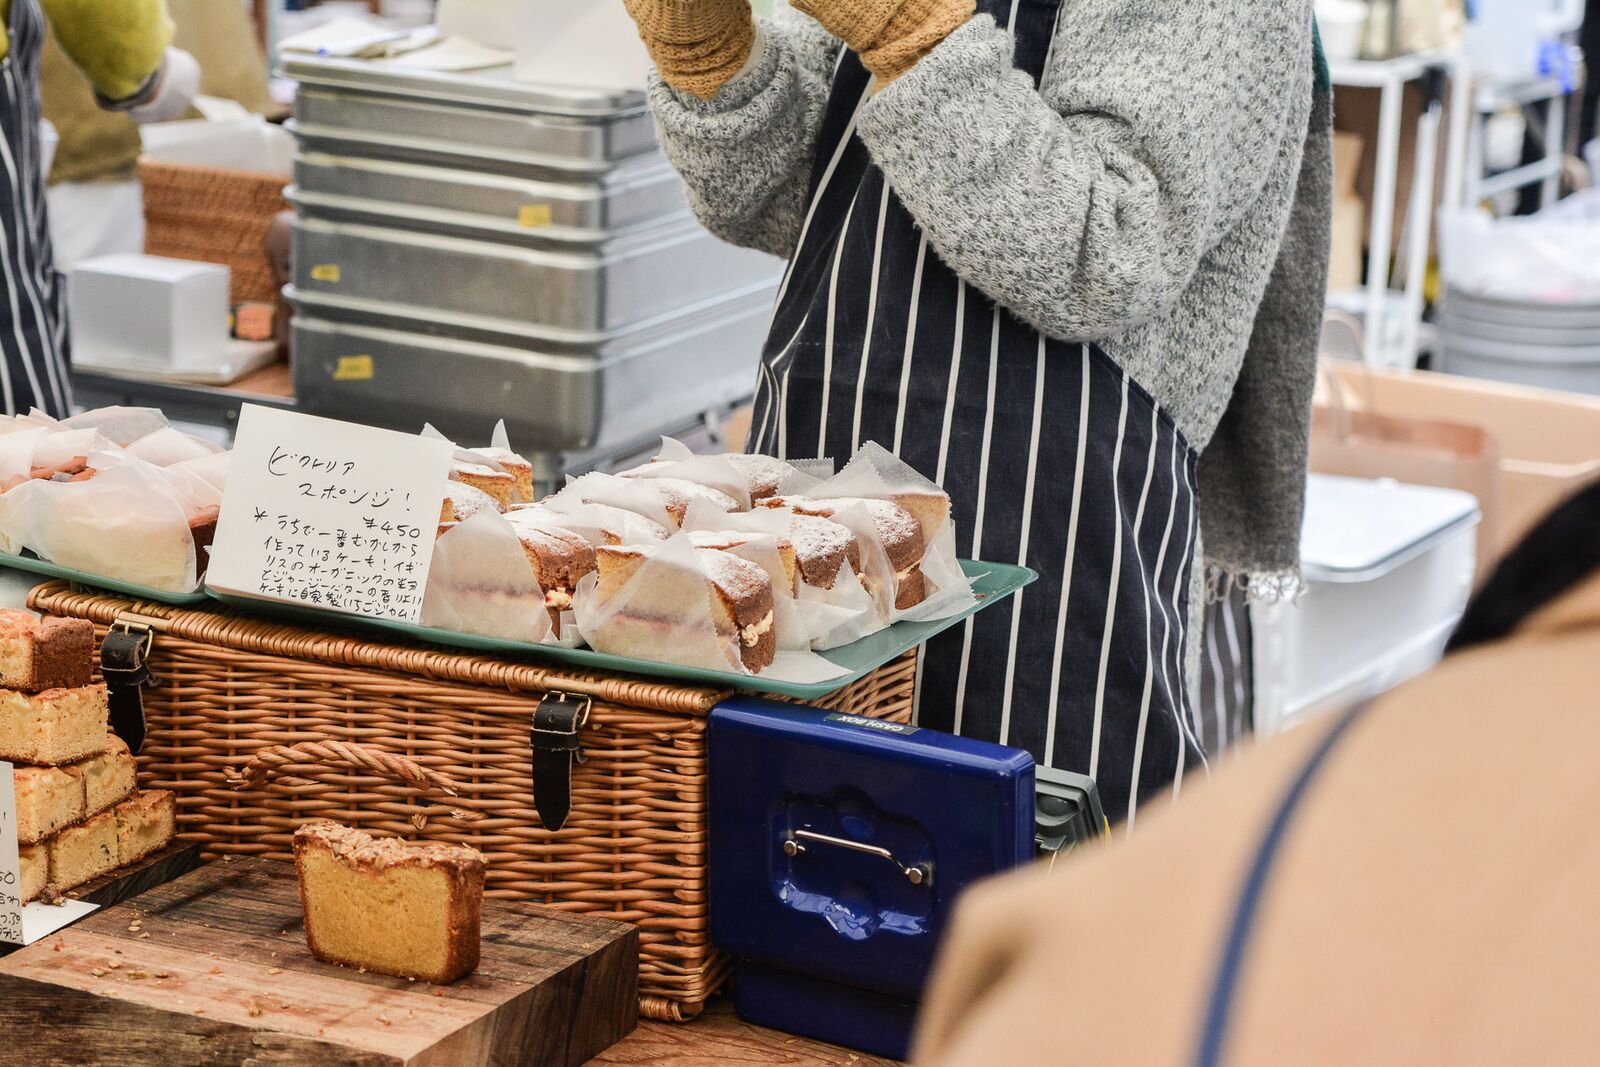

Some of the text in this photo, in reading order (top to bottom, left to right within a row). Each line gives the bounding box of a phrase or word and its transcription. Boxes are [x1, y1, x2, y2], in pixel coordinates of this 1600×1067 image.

[268, 445, 355, 476] ビクトリア
[362, 516, 421, 539] ¥450
[836, 715, 904, 732] CASH BOX
